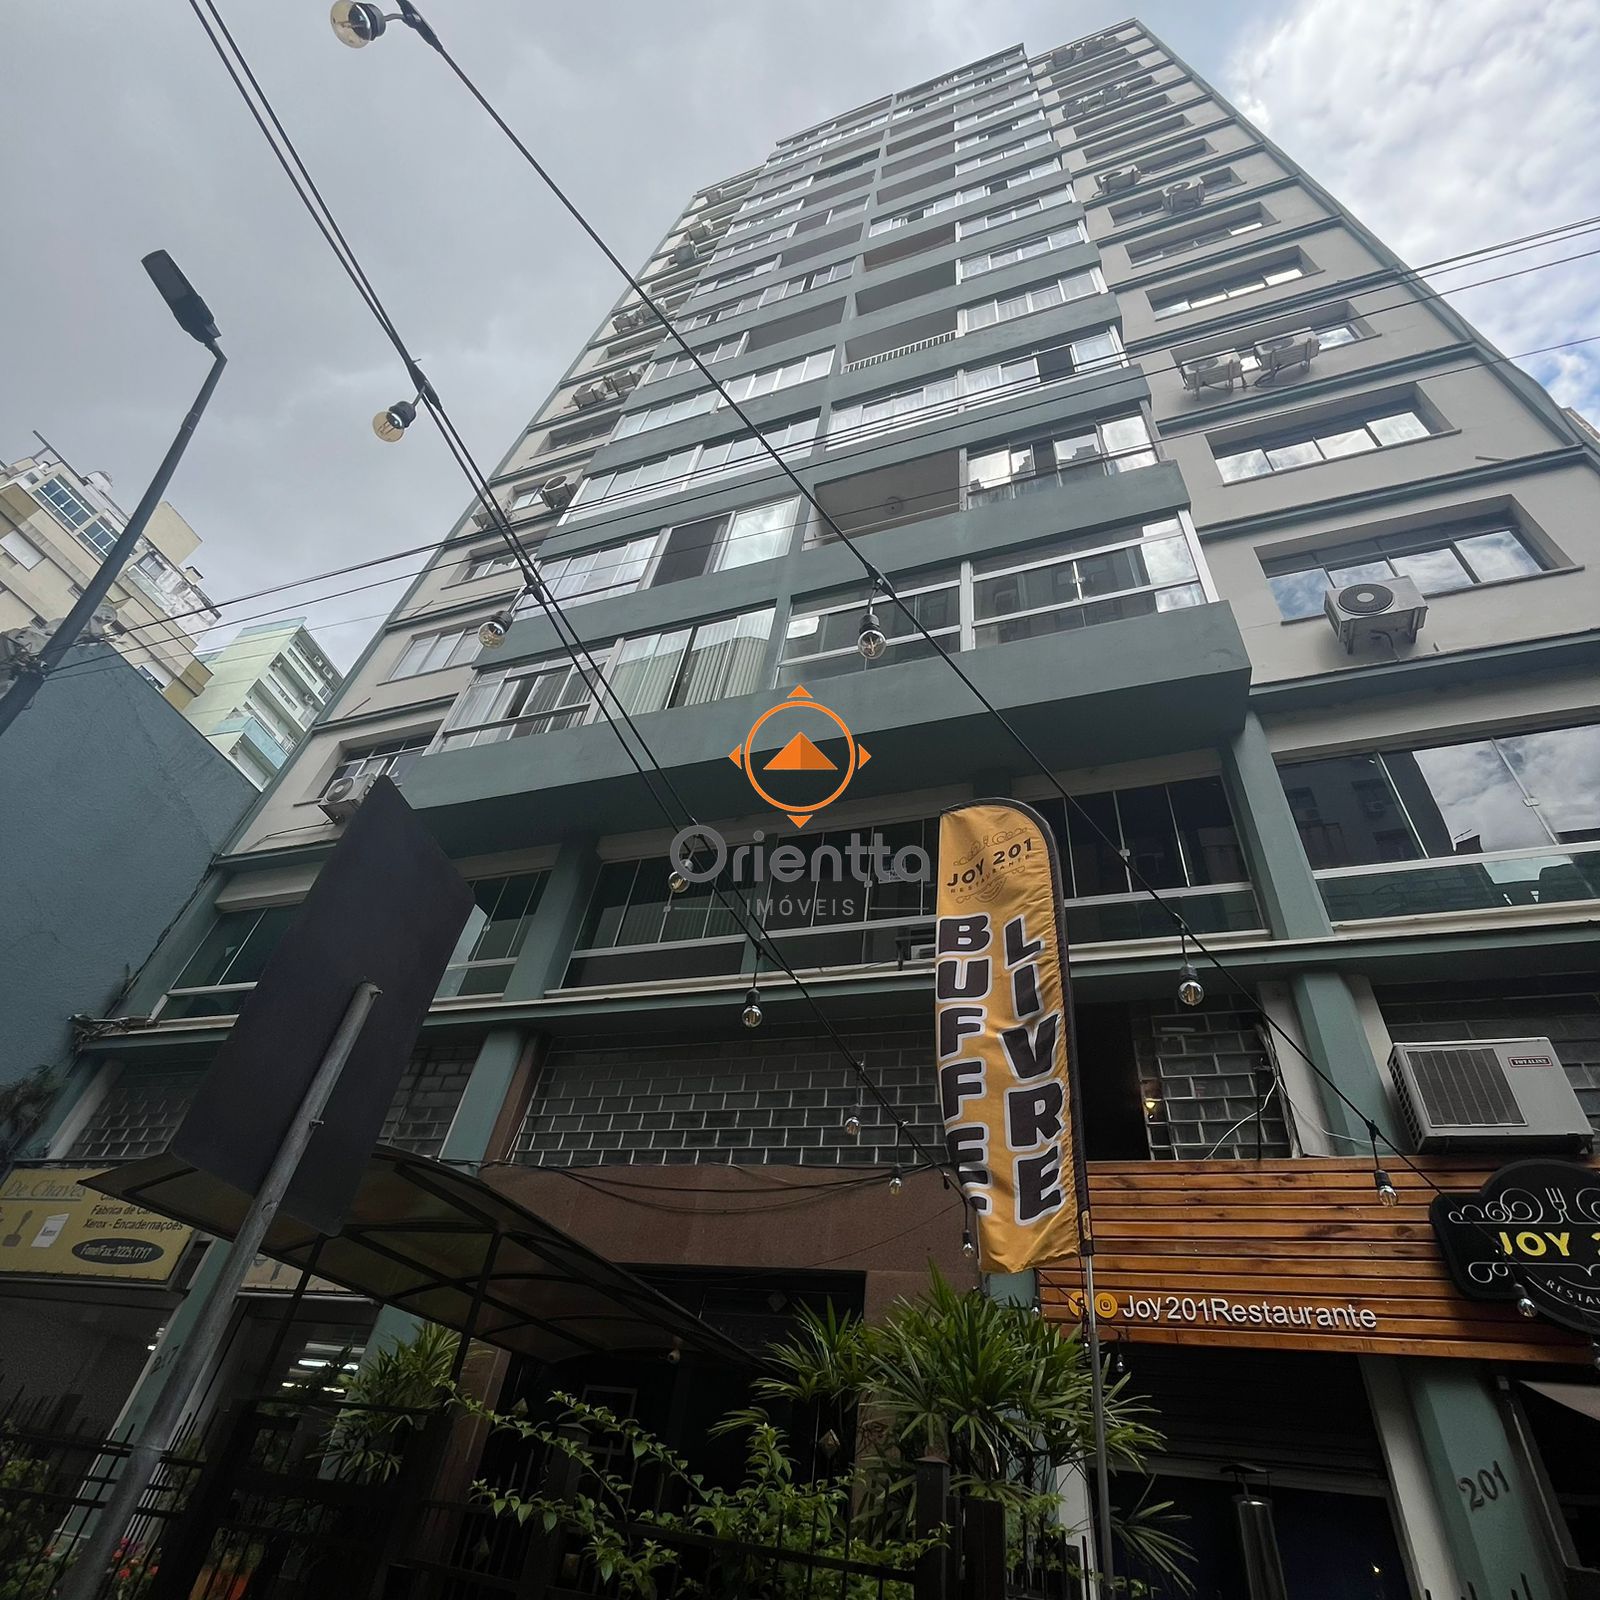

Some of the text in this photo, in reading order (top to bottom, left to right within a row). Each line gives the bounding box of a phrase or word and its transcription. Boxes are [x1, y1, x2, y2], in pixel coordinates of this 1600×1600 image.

[947, 838, 1032, 887] JOY 201
[950, 853, 1030, 894] RESTAURANTE
[999, 913, 1066, 1226] LIVRE
[1496, 1232, 1570, 1257] JOY
[1457, 1460, 1509, 1511] 201
